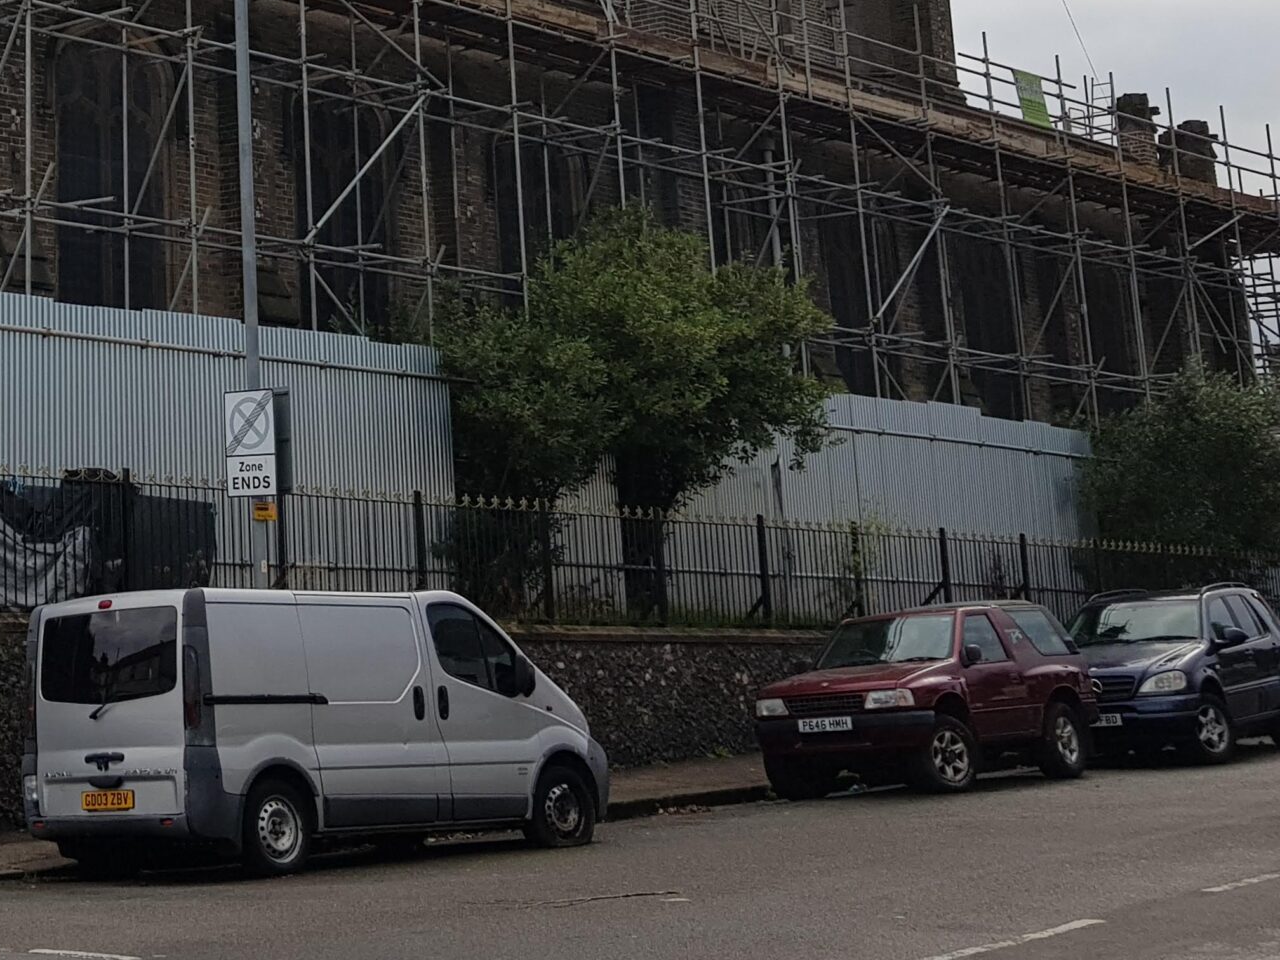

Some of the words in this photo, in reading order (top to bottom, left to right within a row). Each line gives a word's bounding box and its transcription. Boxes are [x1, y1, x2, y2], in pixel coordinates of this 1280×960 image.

[239, 461, 264, 472] Zone
[232, 476, 271, 490] ENDS
[85, 793, 108, 806] GD03
[110, 792, 129, 805] ZBV
